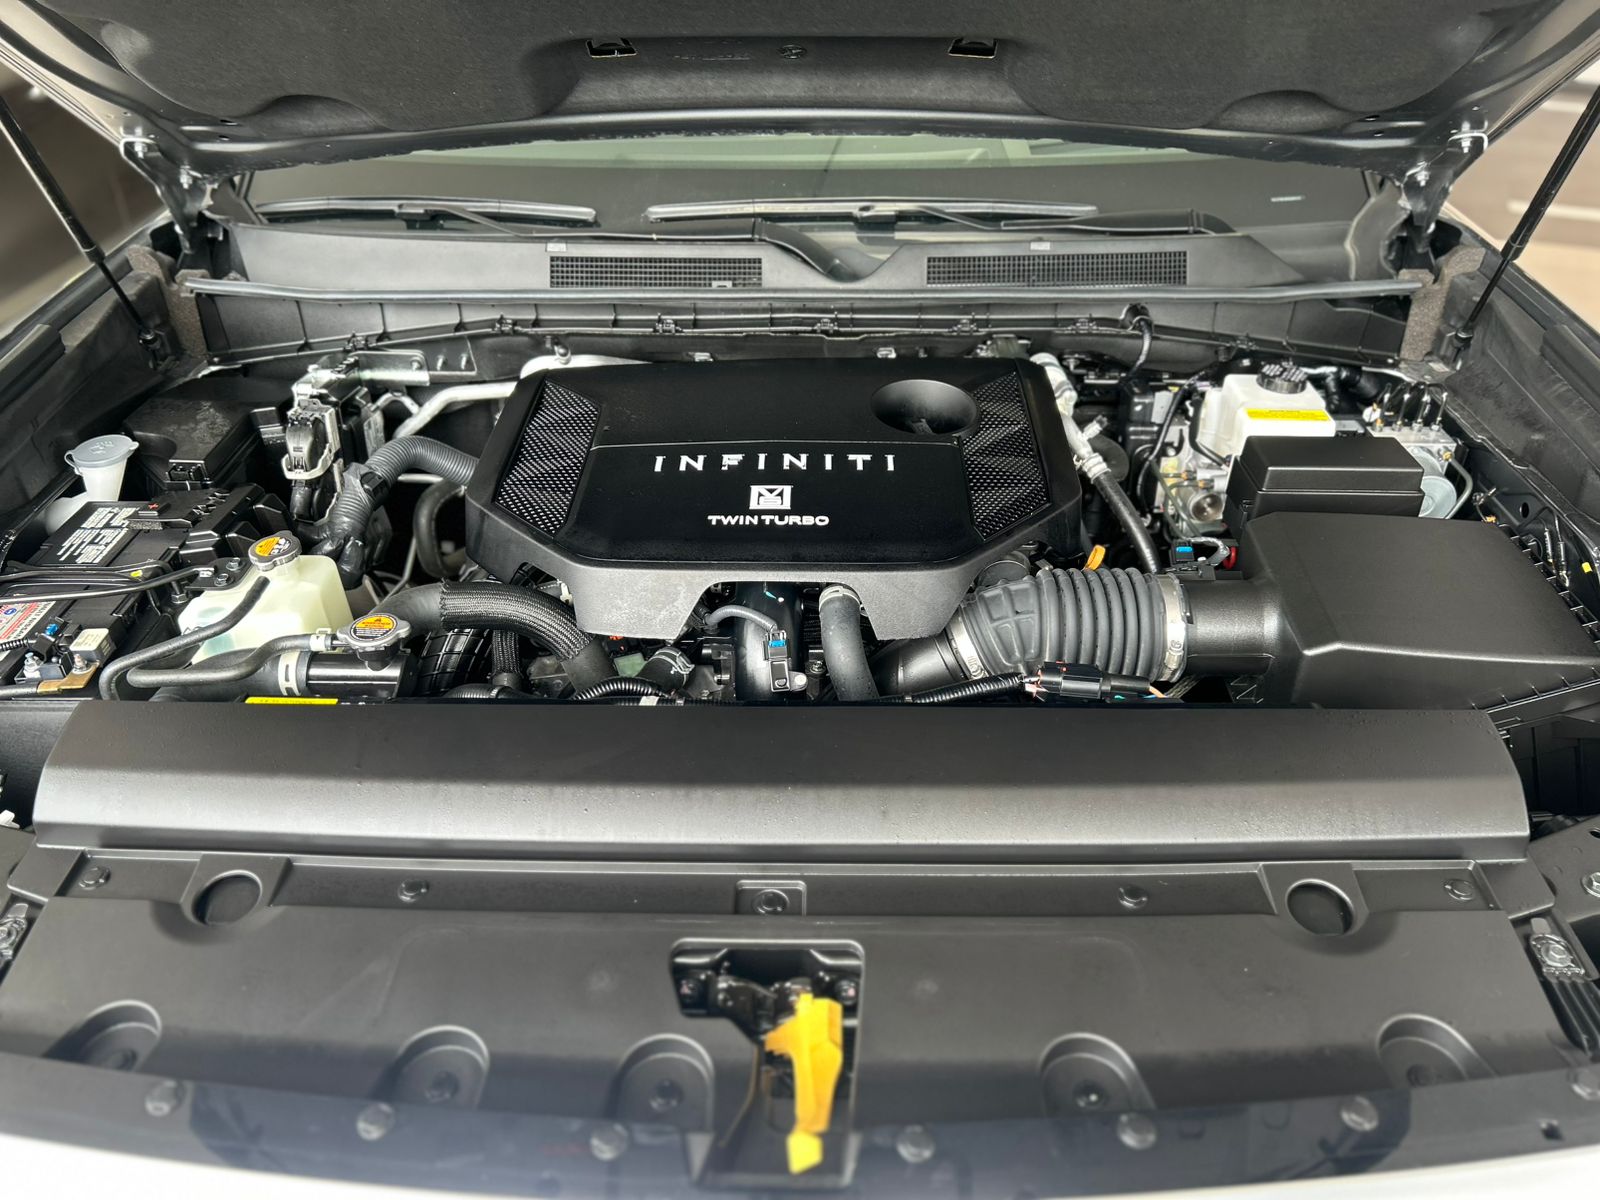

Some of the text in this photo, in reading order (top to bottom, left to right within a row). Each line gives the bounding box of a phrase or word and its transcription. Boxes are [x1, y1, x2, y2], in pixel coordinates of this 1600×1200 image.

[654, 453, 895, 472] INFINITI
[708, 515, 829, 526] TWIN TURBO
